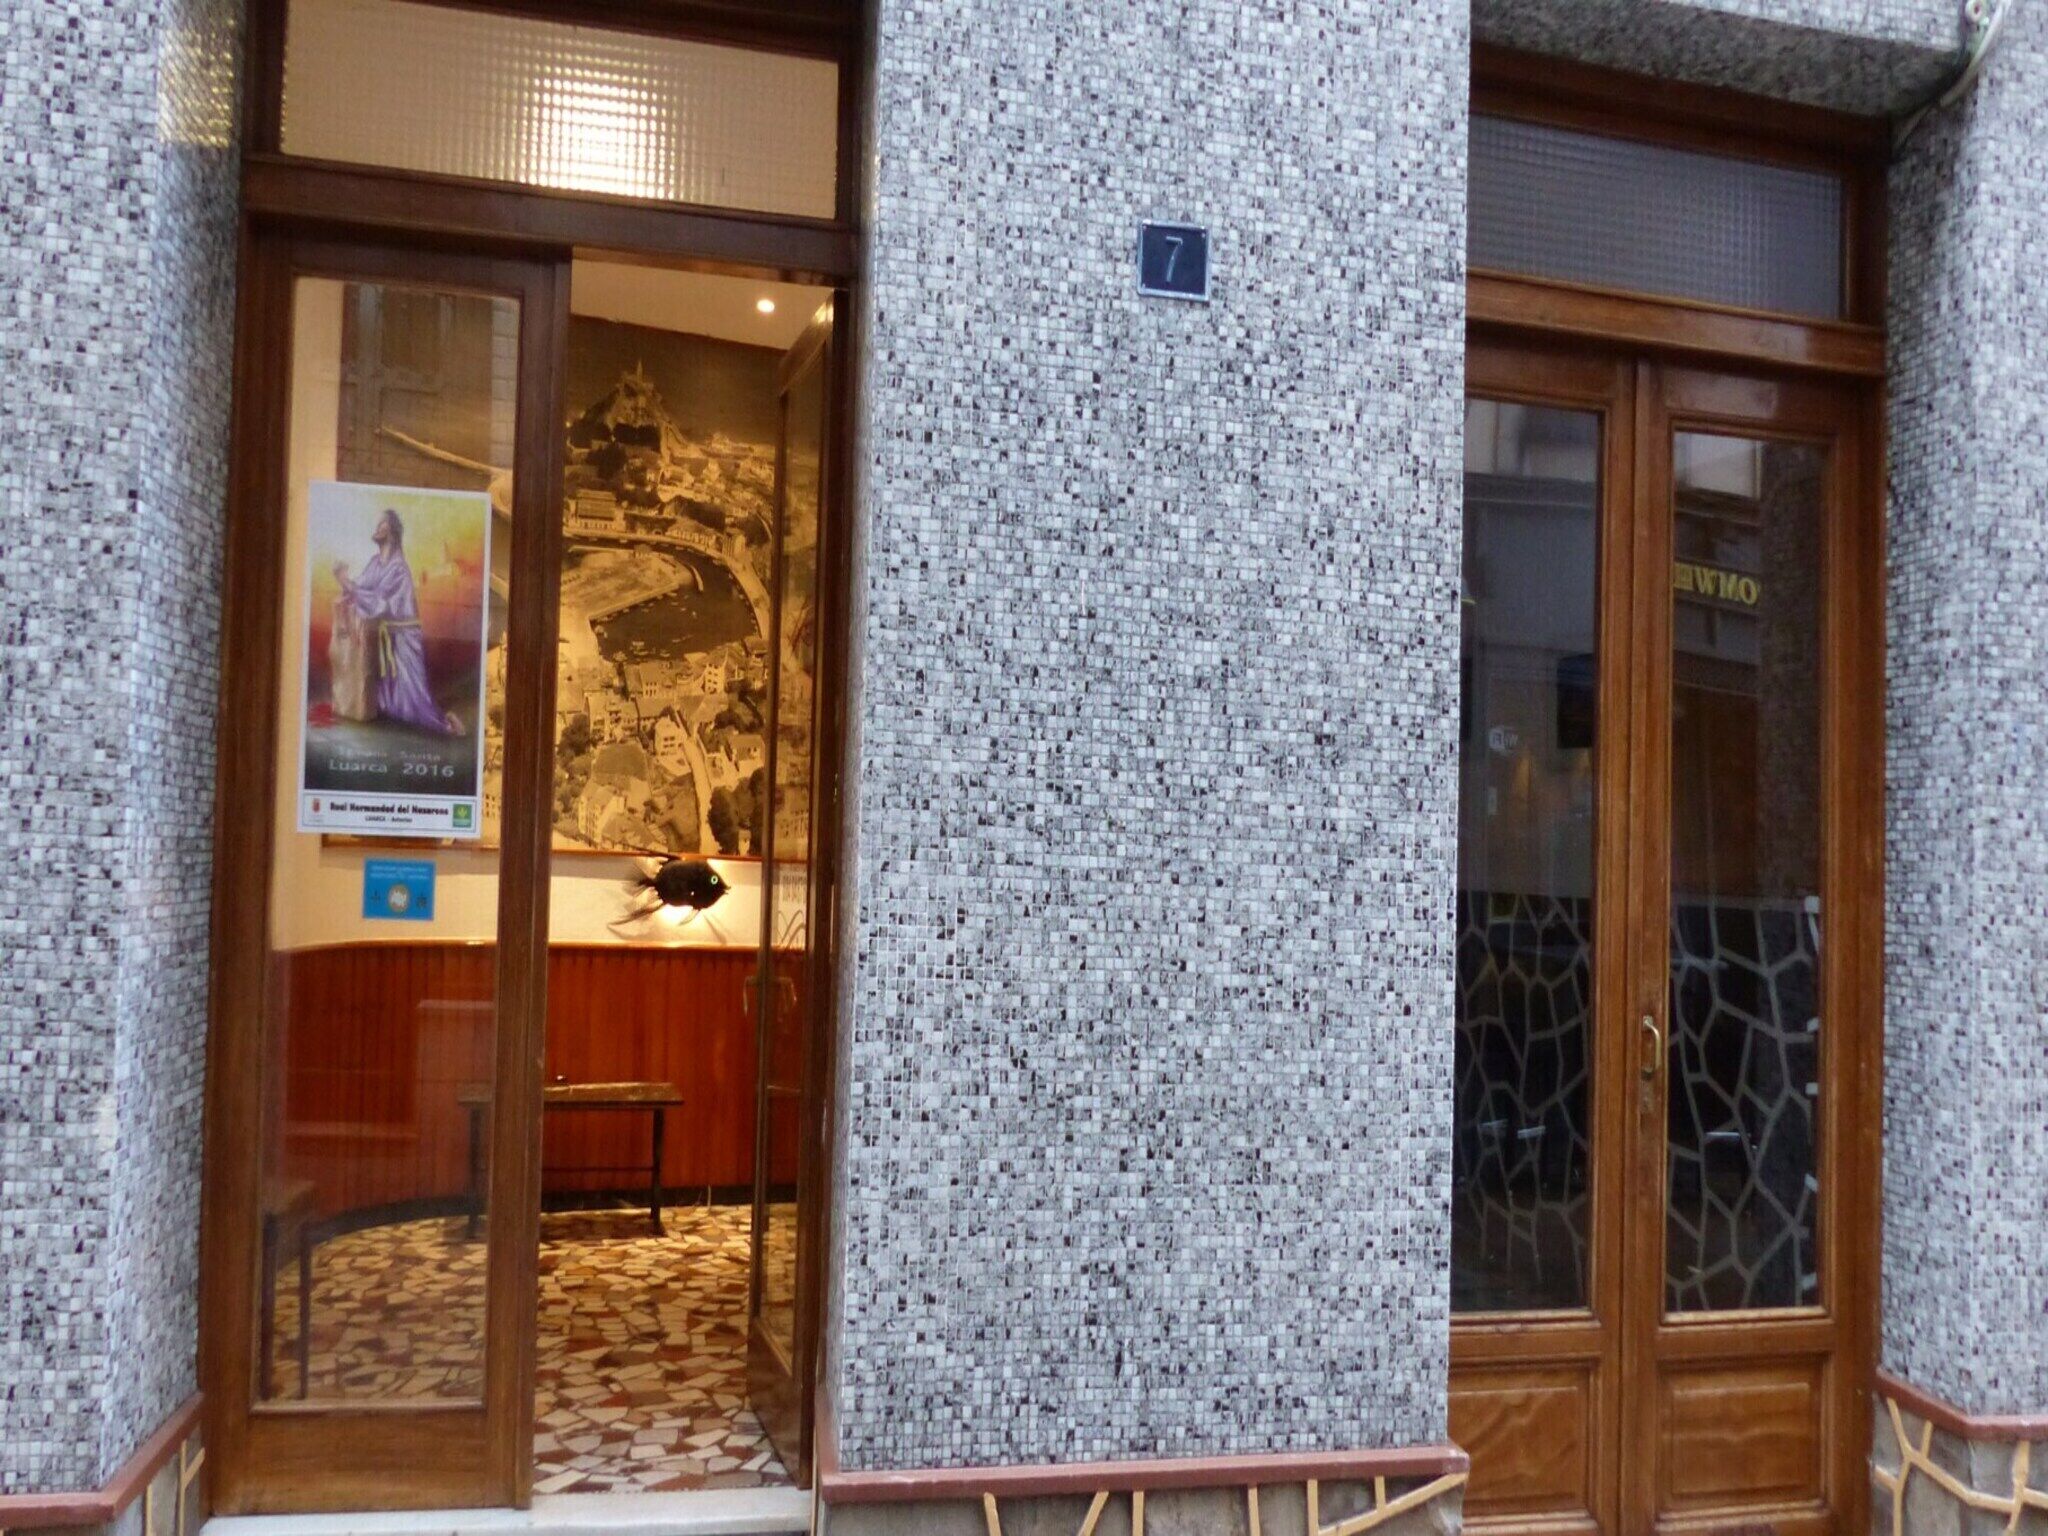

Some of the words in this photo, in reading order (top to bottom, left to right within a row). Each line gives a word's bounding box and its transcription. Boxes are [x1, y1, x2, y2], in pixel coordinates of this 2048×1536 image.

[1165, 235, 1184, 282] 7
[329, 759, 388, 774] Luarca
[402, 762, 455, 778] 2016
[397, 804, 409, 814] del
